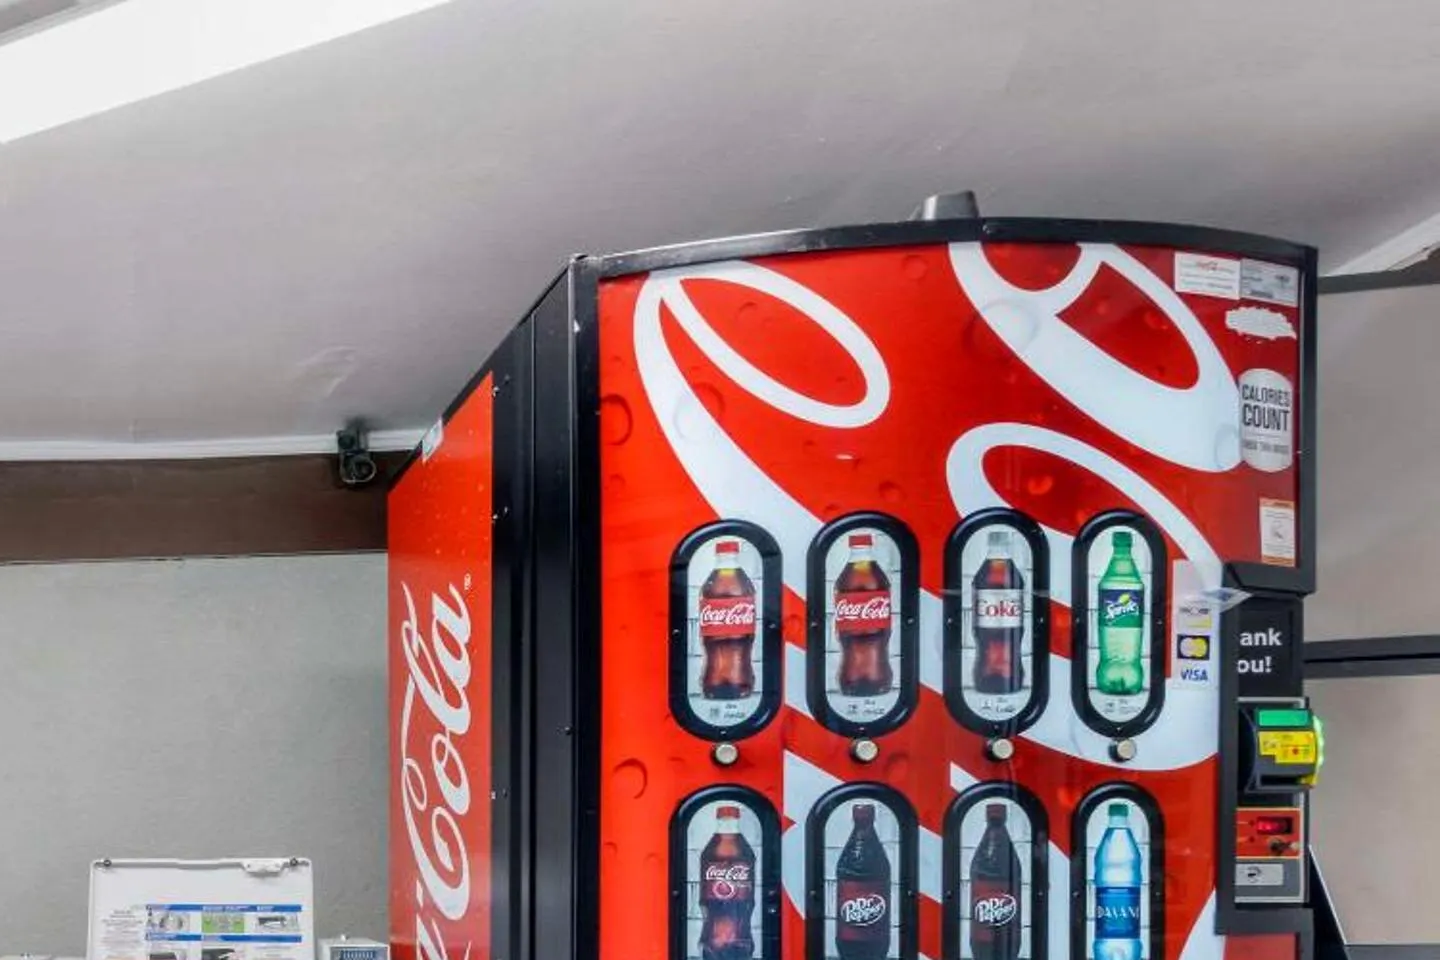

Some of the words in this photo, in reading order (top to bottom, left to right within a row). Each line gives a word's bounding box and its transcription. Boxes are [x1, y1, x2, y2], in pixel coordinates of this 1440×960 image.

[1242, 384, 1290, 407] CALORIES
[1242, 403, 1290, 431] COUNT
[700, 602, 754, 626] Coca-Cola
[835, 597, 890, 622] Coca-Cola
[1181, 669, 1208, 680] VISA
[706, 864, 751, 881] Coca-Cola
